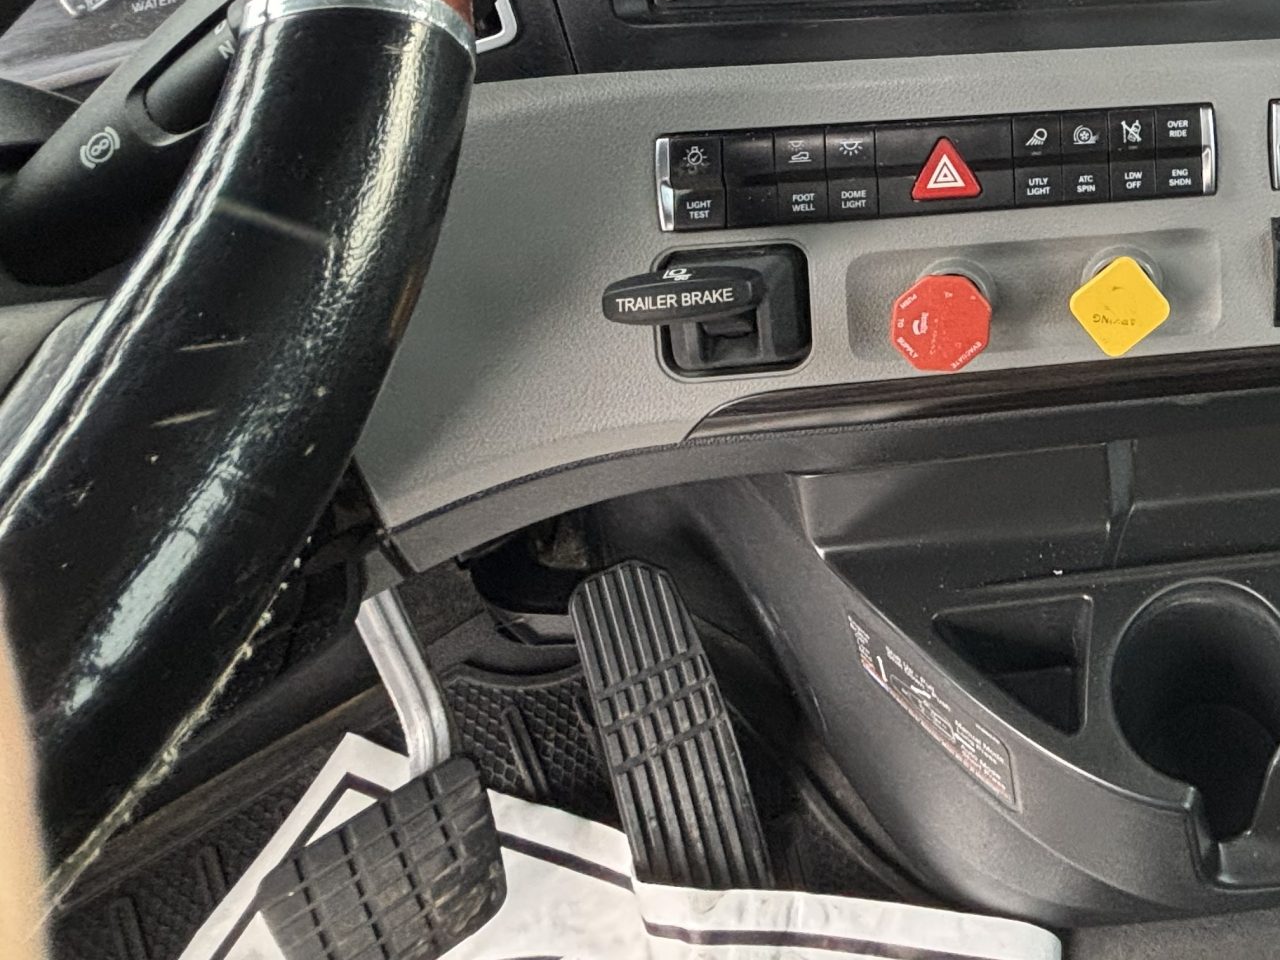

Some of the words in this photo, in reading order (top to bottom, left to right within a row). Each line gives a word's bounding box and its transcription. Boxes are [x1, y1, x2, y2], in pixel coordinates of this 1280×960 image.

[1167, 119, 1189, 129] OVER
[1168, 128, 1188, 138] RIDE
[1124, 171, 1143, 180] LDW
[1171, 168, 1189, 177] ENG
[1028, 177, 1049, 186] UTLY
[1078, 174, 1094, 184] ATC
[1168, 177, 1192, 187] SHDN
[1077, 184, 1096, 193] SPIN
[1126, 180, 1141, 190] OFF
[841, 189, 866, 199] DOME
[1027, 186, 1051, 196] LIGHT
[792, 193, 815, 203] FOOT
[686, 200, 711, 210] LIGHT
[792, 202, 816, 212] WELL
[841, 199, 866, 209] LIGHT
[689, 209, 710, 219] TEST
[616, 294, 678, 313] TRAILER
[681, 288, 734, 306] BRAKE
[899, 293, 918, 310] PUSH
[897, 318, 905, 329] TO
[896, 336, 919, 359] SUPPLY
[950, 341, 982, 369] EVACUATE
